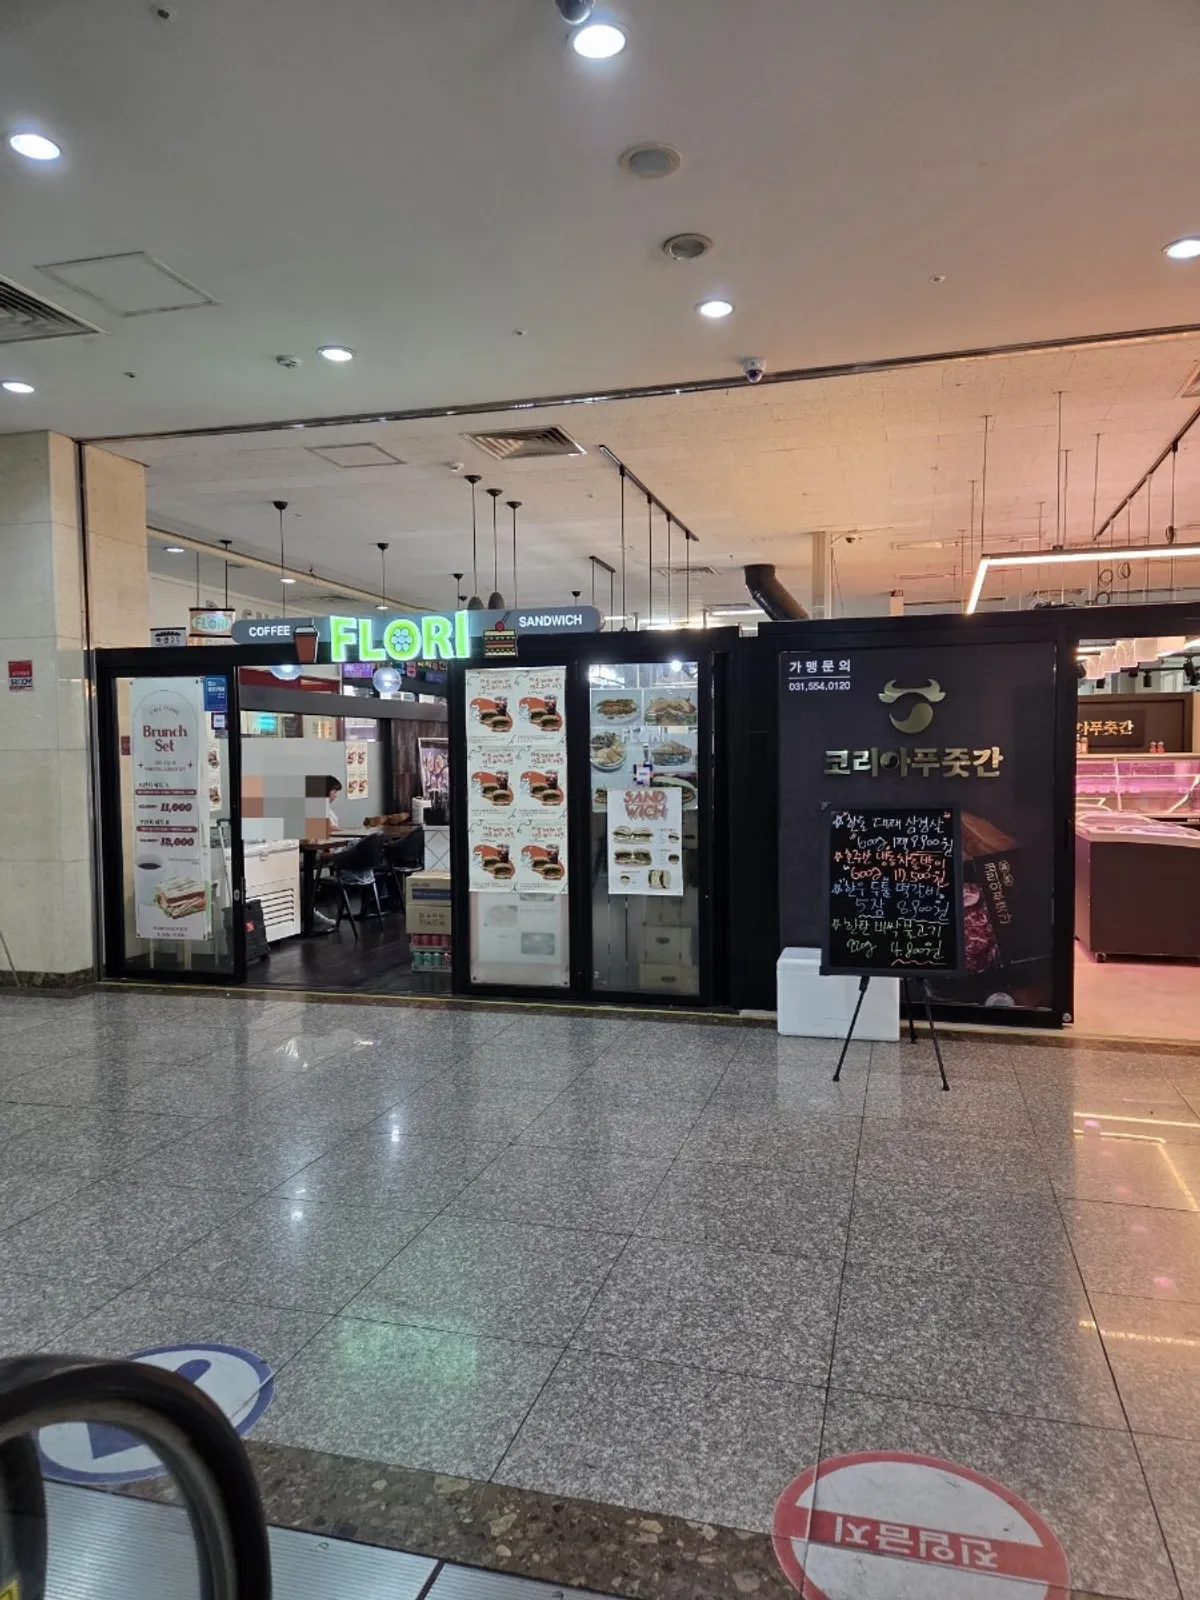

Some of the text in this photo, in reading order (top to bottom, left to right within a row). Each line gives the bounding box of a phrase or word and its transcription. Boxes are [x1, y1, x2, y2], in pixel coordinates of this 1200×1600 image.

[195, 617, 228, 629] FLORI
[519, 615, 582, 627] SANDWICH
[249, 625, 291, 637] COFFEE
[330, 610, 470, 662] FLORI
[143, 725, 187, 737] Brunch
[155, 739, 174, 752] Set
[823, 746, 1004, 778] 코리아푸줏간
[623, 790, 667, 804] SAND
[160, 803, 192, 812] 11,000
[625, 804, 668, 821] WICH
[835, 1516, 998, 1568] 진입금지
